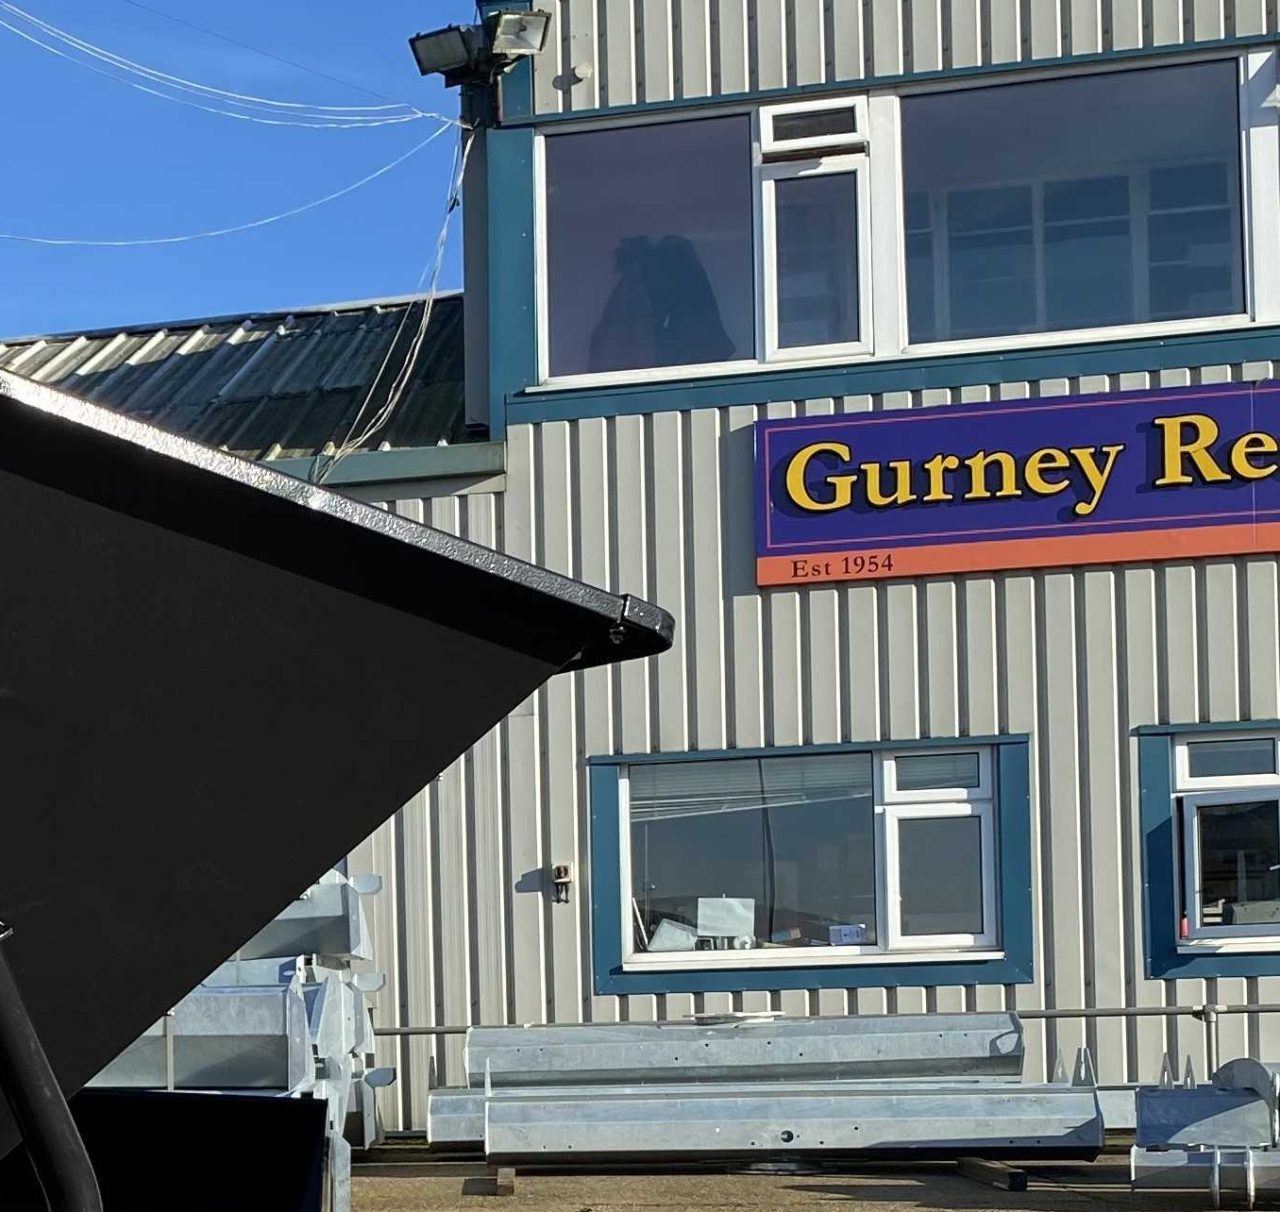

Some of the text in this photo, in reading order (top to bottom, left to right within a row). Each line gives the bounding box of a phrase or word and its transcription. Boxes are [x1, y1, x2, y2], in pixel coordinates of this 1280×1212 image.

[784, 412, 1280, 516] Gurney Re
[790, 554, 894, 578] Est 1954
